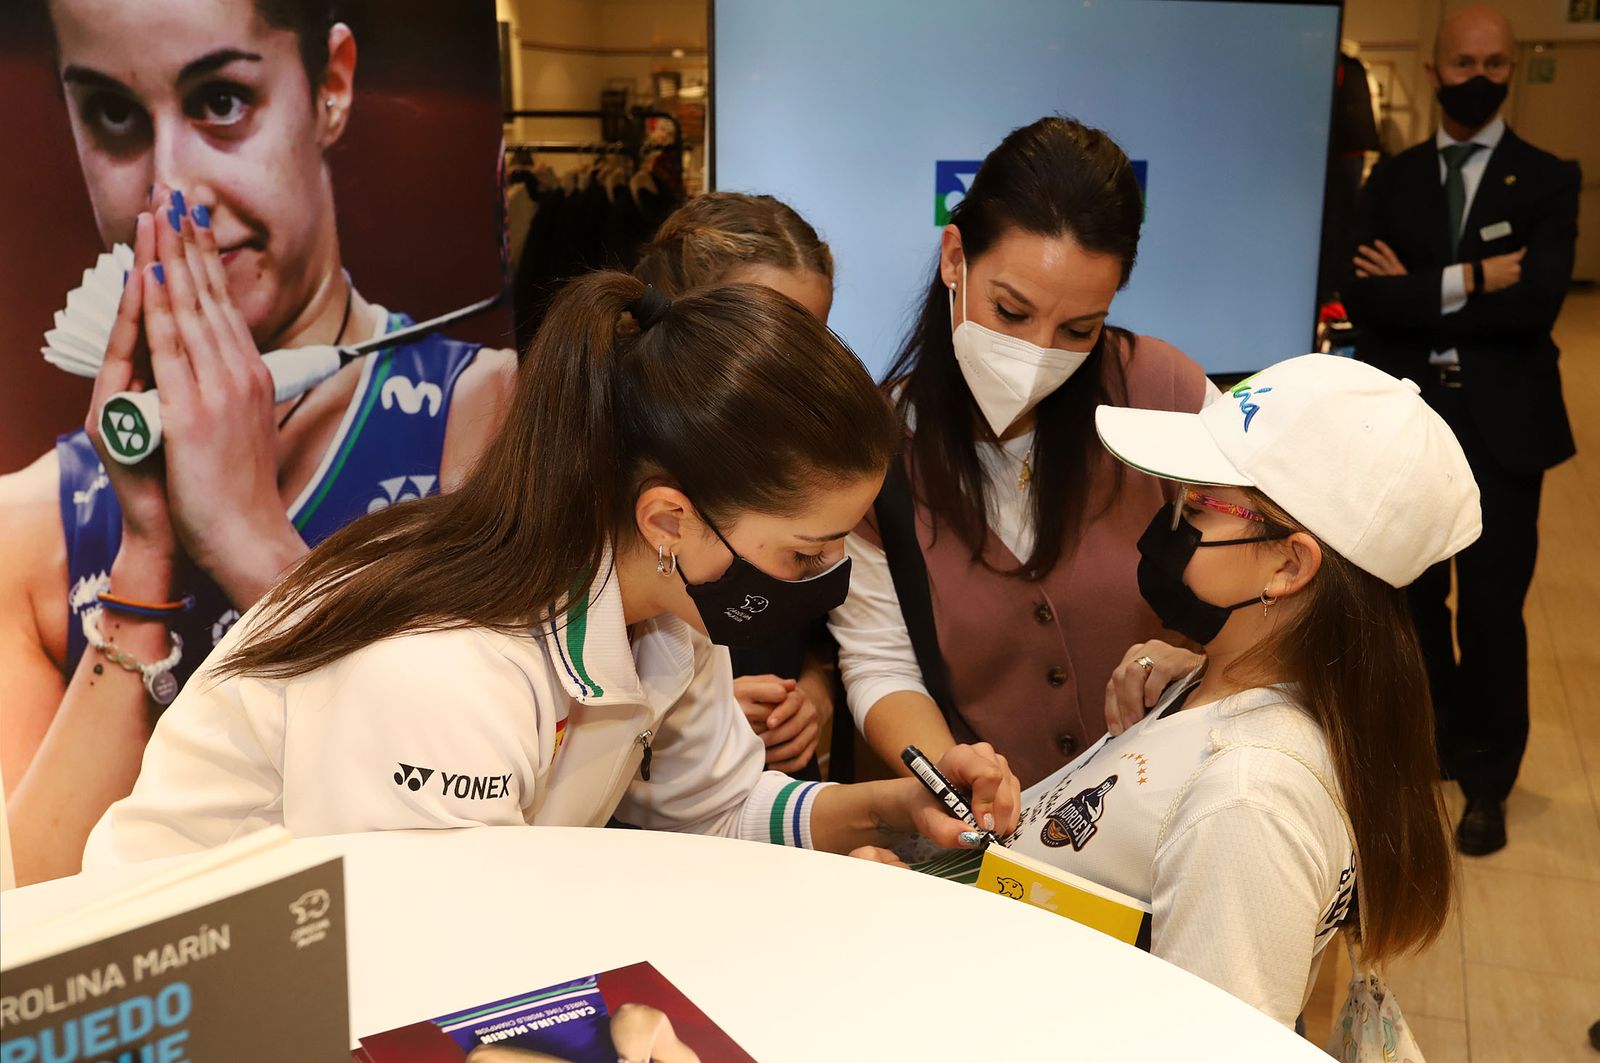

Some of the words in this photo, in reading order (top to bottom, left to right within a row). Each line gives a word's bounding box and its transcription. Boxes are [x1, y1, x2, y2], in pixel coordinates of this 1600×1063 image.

[441, 771, 513, 800] YONEX
[133, 923, 231, 982] MARÍN
[0, 981, 192, 1063] PUEDO
[474, 1020, 516, 1036] CHAMPION
[516, 1011, 545, 1023] WORLD
[527, 1006, 596, 1031] CAROLINA
